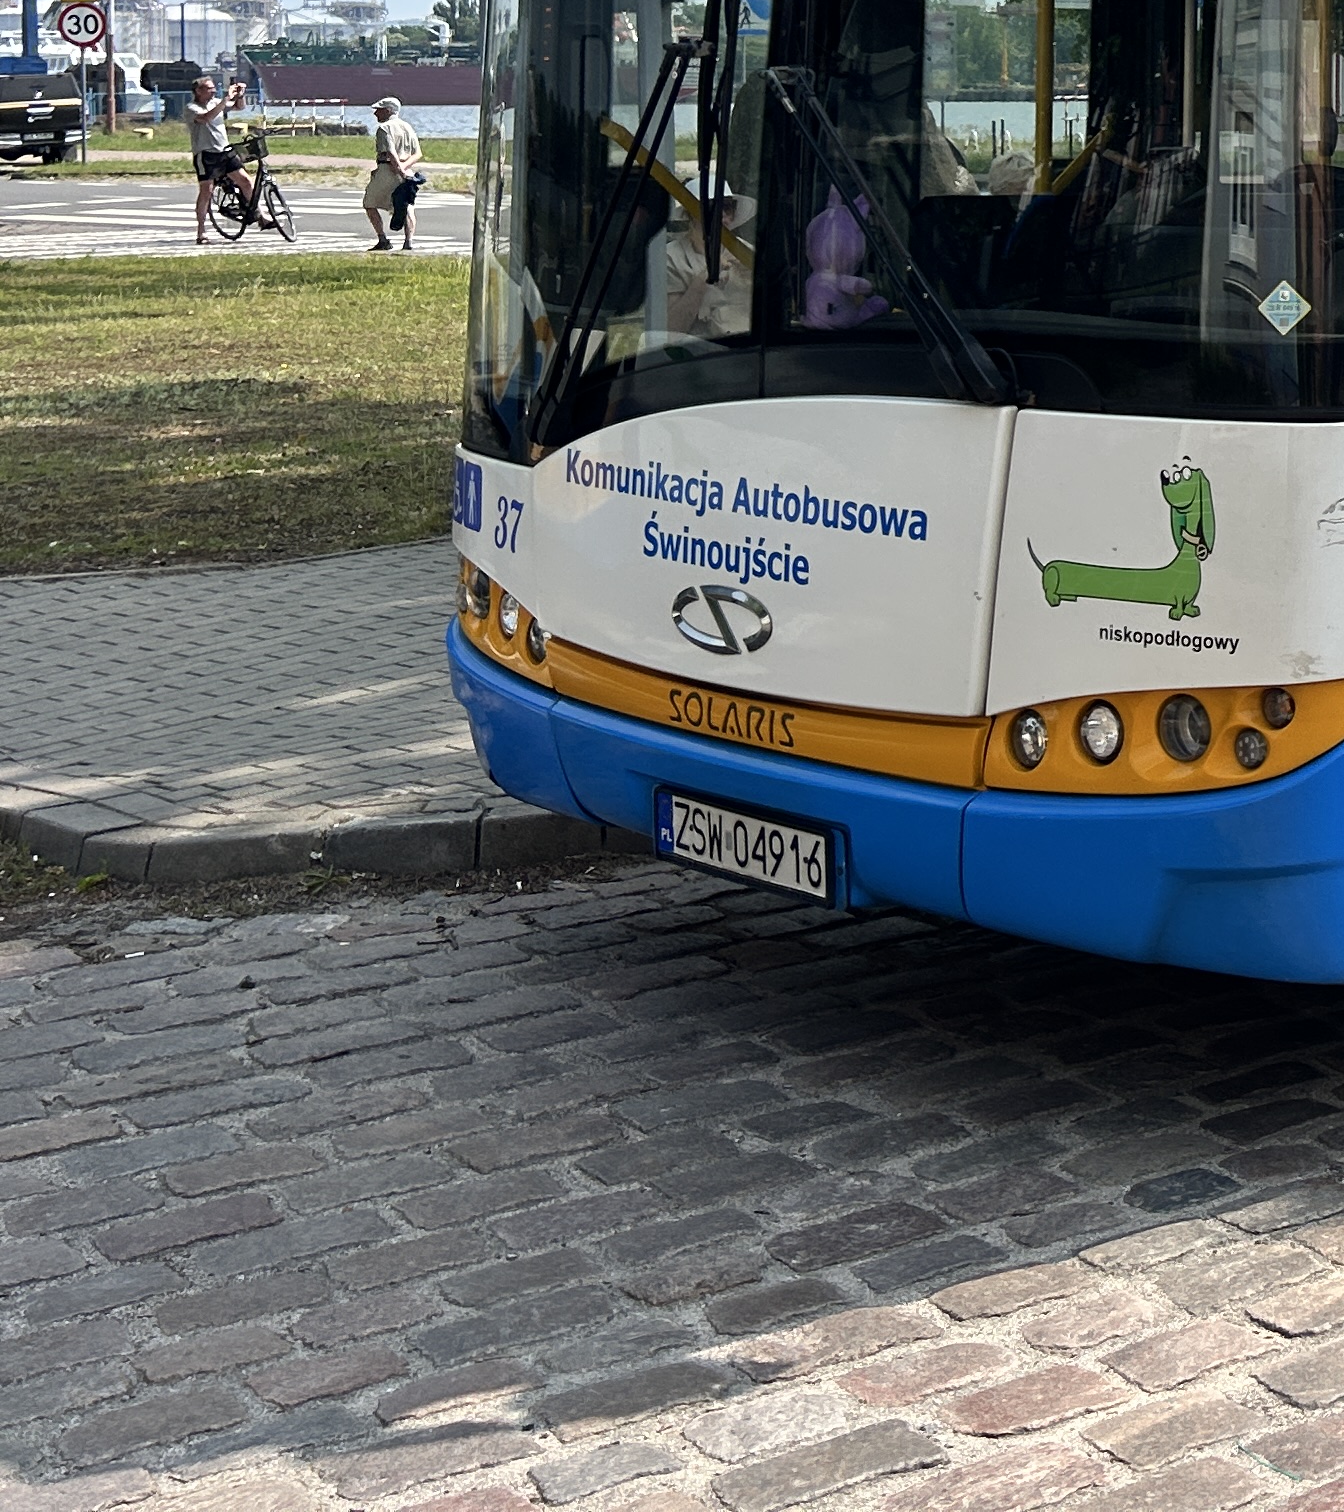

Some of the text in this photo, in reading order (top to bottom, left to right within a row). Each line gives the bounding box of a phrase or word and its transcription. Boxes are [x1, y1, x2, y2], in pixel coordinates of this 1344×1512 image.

[67, 14, 99, 36] 30
[494, 495, 525, 554] 37
[565, 448, 928, 542] Komunikacja Autobusowa
[643, 511, 810, 585] Świnoujście
[1099, 624, 1240, 654] niskopodłogowy
[669, 688, 795, 748] SOLARIS
[660, 827, 673, 842] PL
[674, 801, 822, 888] ZSW 04916
